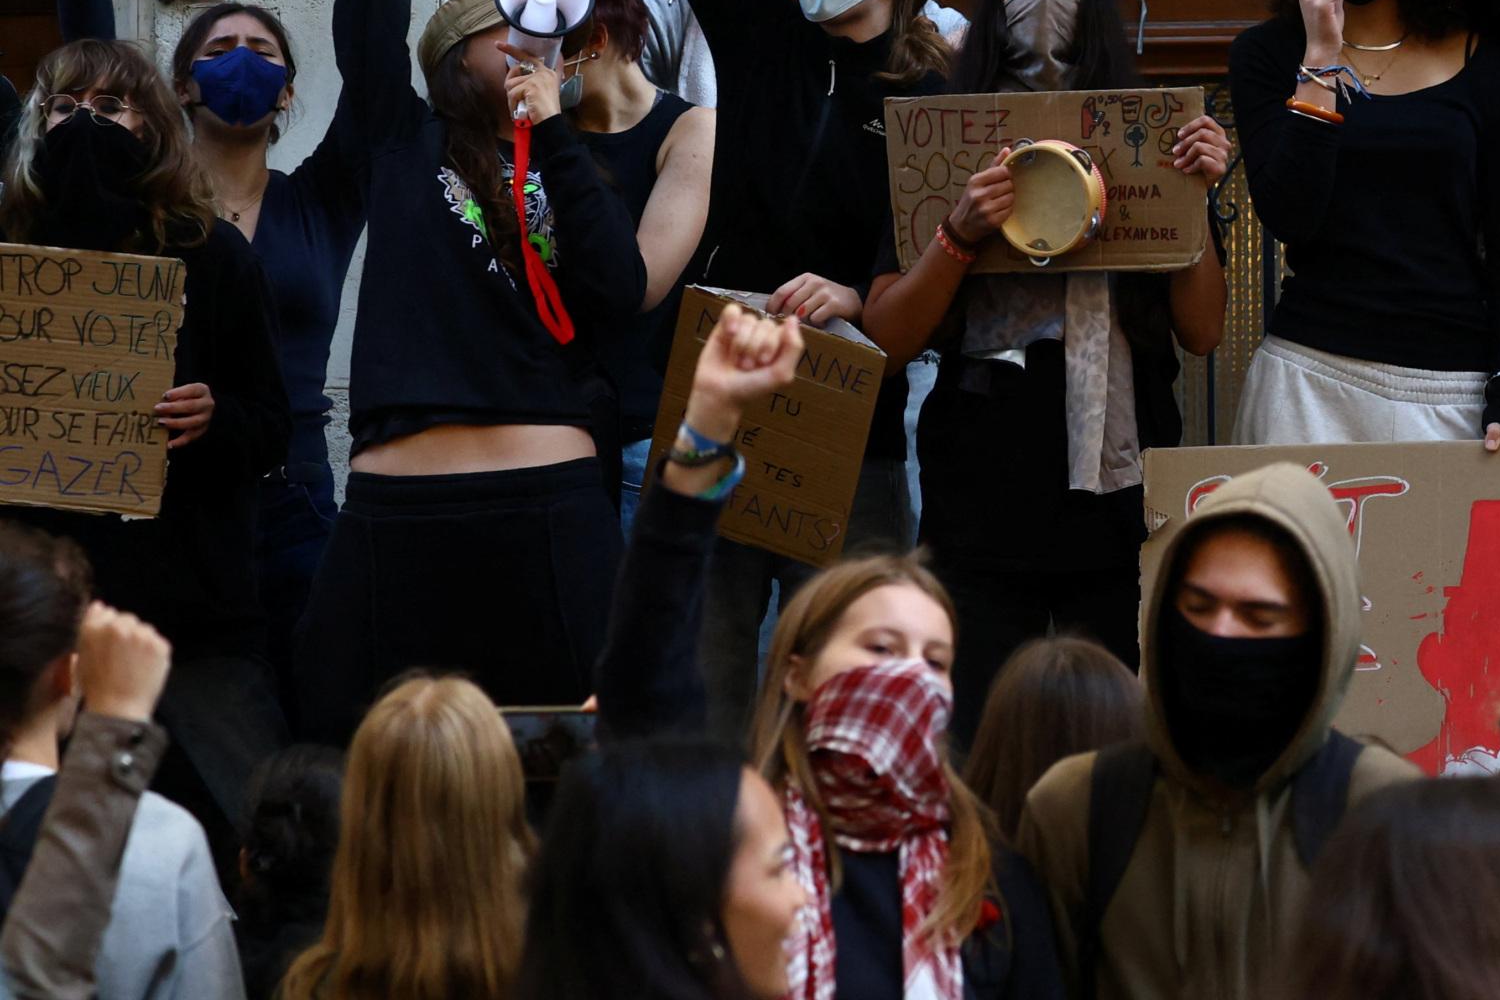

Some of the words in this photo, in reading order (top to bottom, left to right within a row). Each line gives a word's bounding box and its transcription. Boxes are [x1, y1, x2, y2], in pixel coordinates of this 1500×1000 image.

[895, 107, 1013, 148] VOTEZ
[1106, 184, 1162, 201] OHANA
[1119, 205, 1131, 221] &
[0, 305, 54, 343] OUR
[72, 309, 172, 360] VOTER
[770, 392, 801, 417] TU
[48, 412, 84, 443] SE
[763, 462, 803, 488] TES
